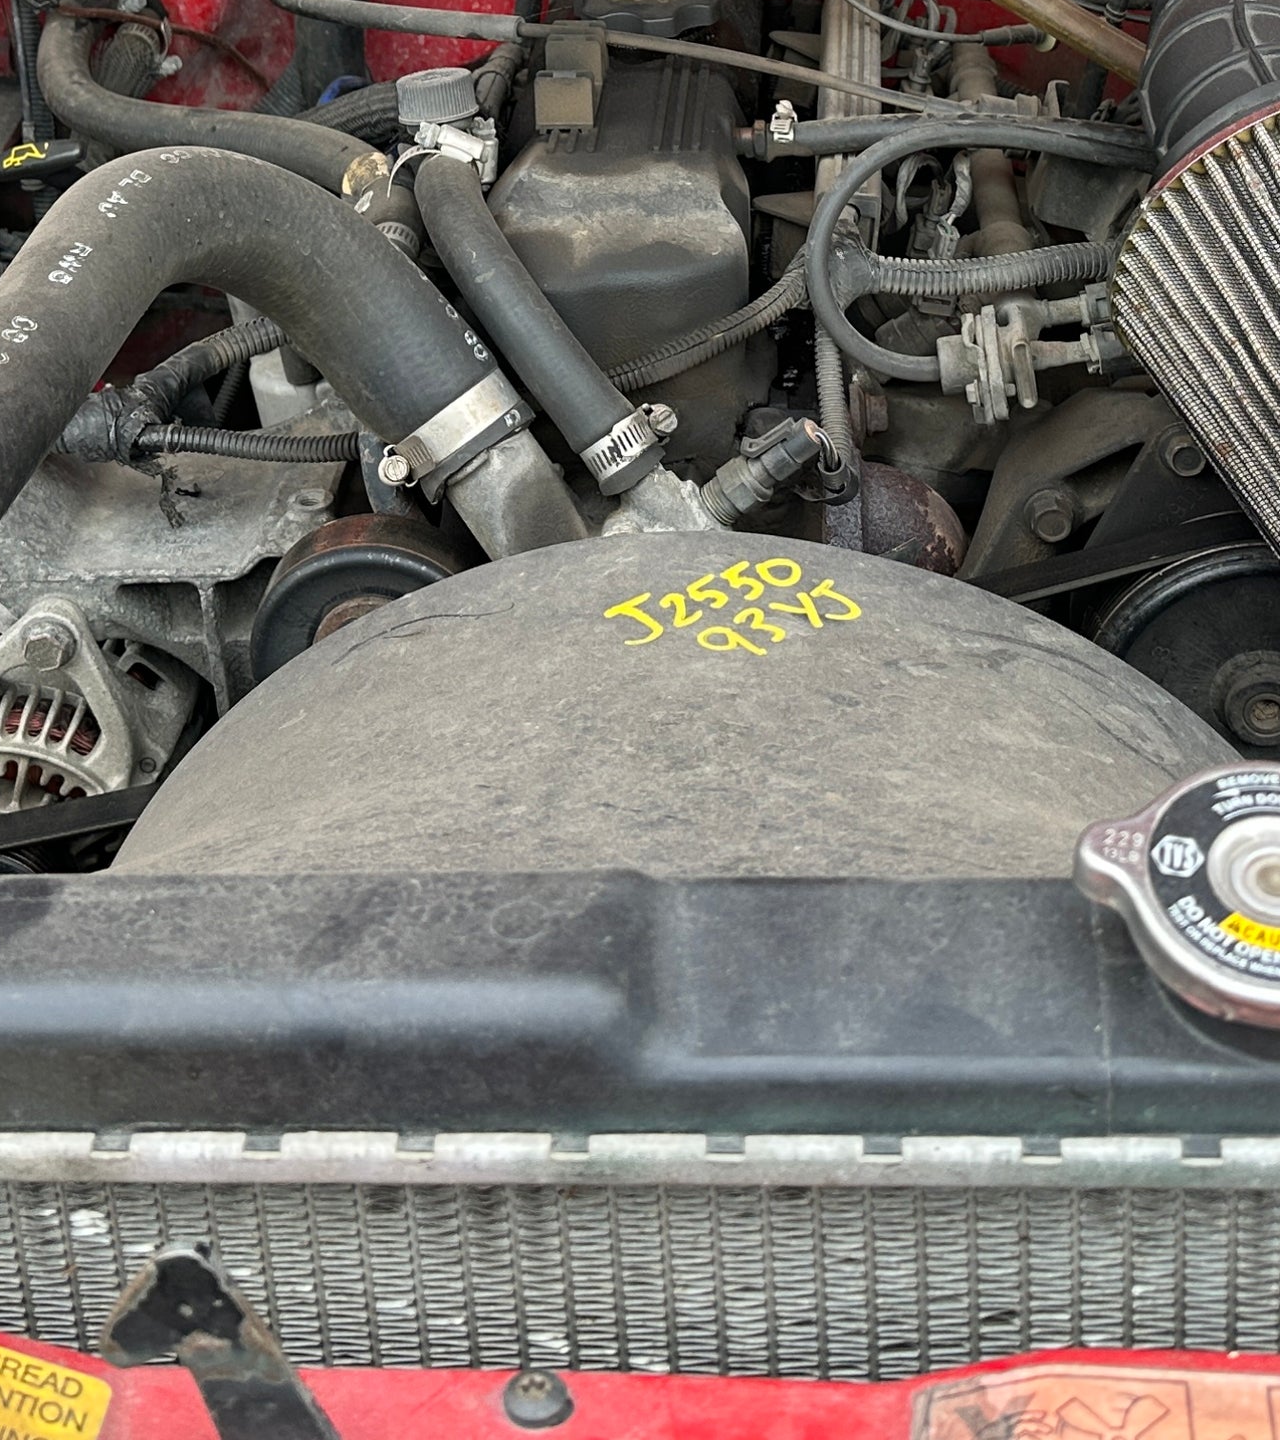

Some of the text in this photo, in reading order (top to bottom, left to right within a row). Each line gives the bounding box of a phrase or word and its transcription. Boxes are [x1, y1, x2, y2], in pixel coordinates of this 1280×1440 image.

[603, 558, 803, 646] J2550
[696, 579, 862, 656] 93YJ
[1211, 794, 1254, 816] TURN
[1102, 828, 1145, 848] 229
[1177, 895, 1205, 922] DO
[1196, 915, 1238, 948] NOT
